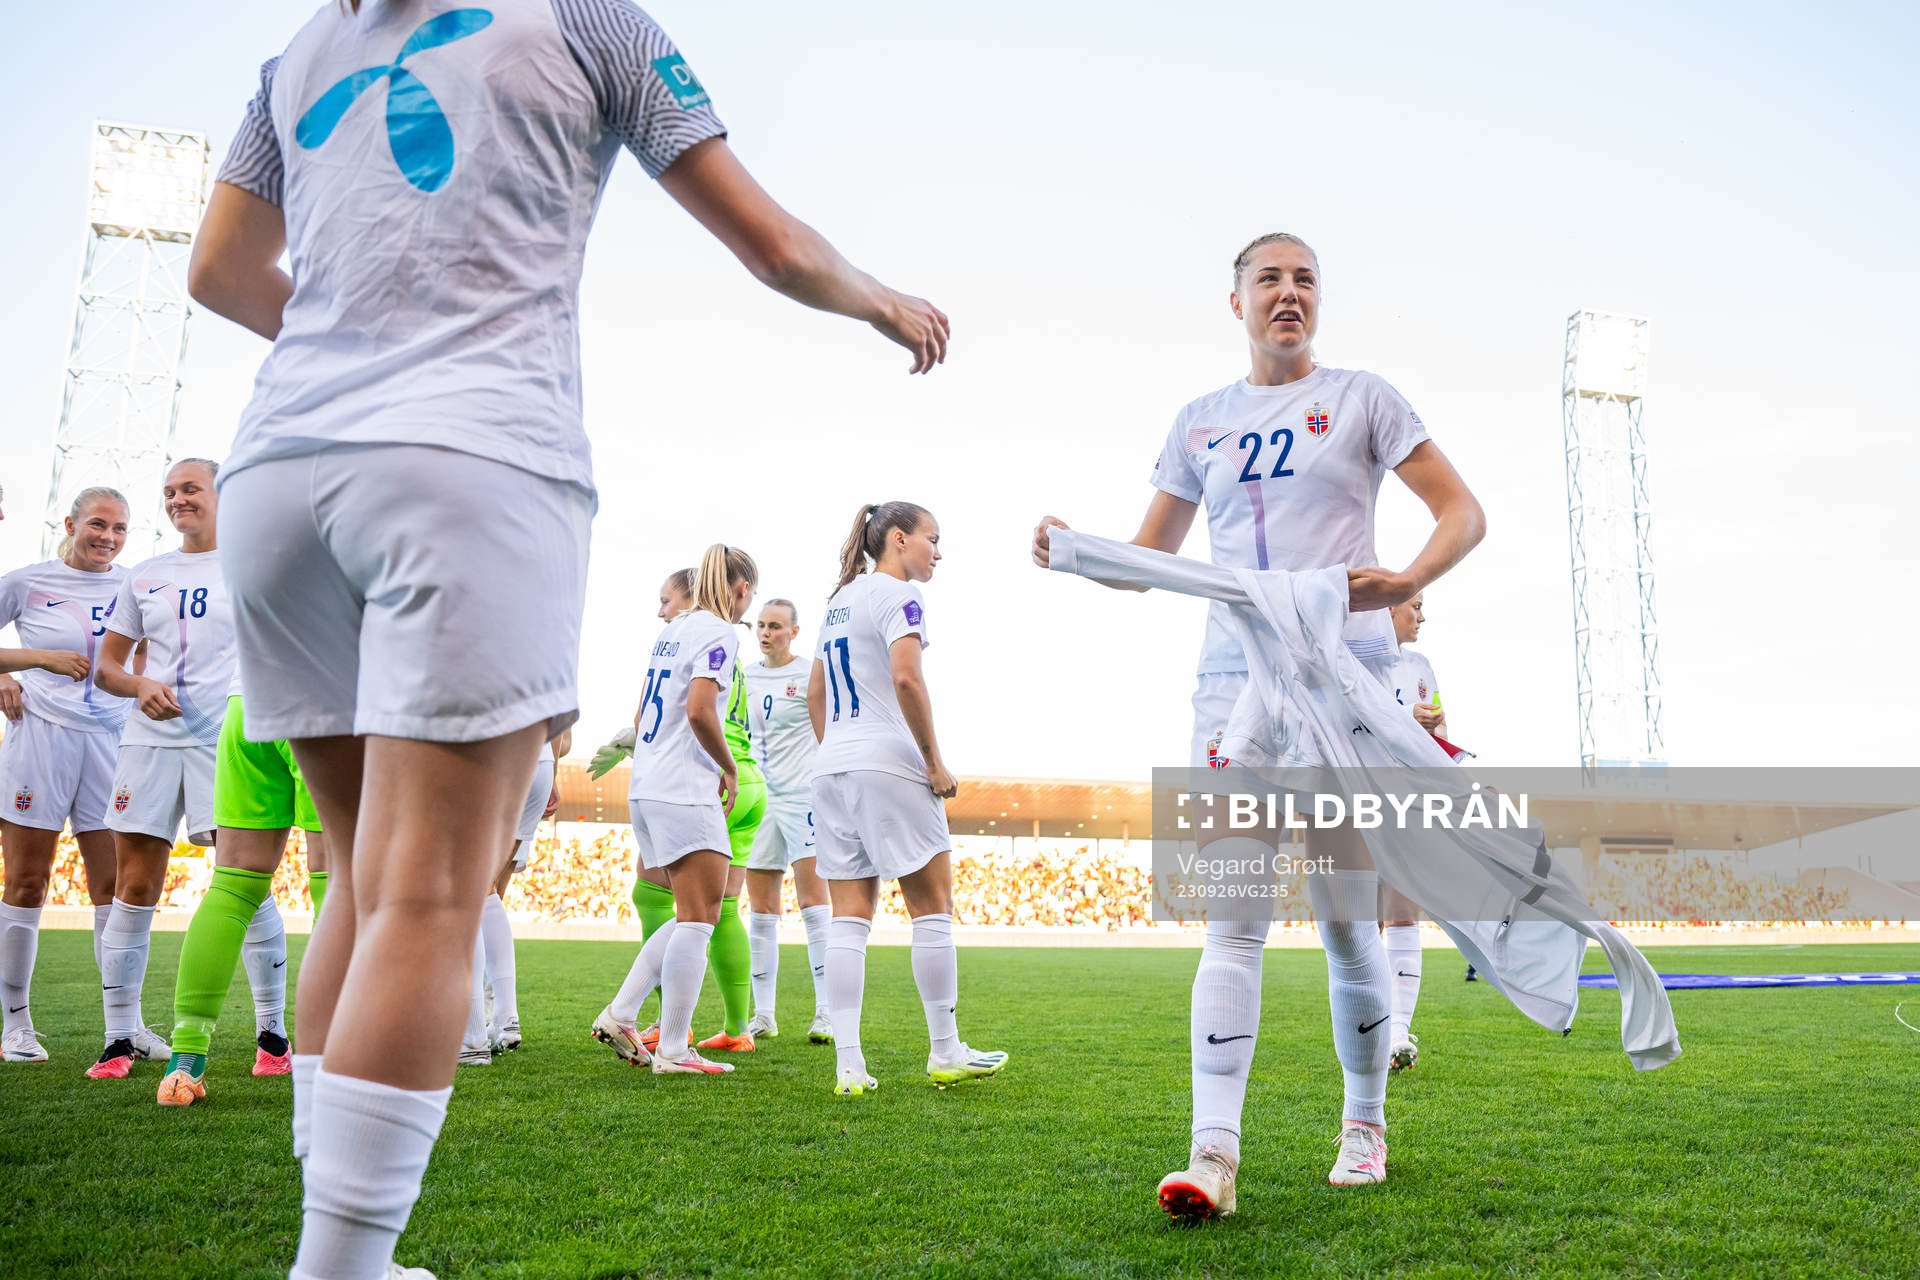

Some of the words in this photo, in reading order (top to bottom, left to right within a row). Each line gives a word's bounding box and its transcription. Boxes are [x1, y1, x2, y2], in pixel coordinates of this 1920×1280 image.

[1238, 428, 1295, 483] 22
[178, 587, 208, 620] 18
[825, 606, 851, 627] REITEN
[91, 606, 106, 636] 5
[823, 636, 860, 722] 11
[763, 694, 773, 721] 9
